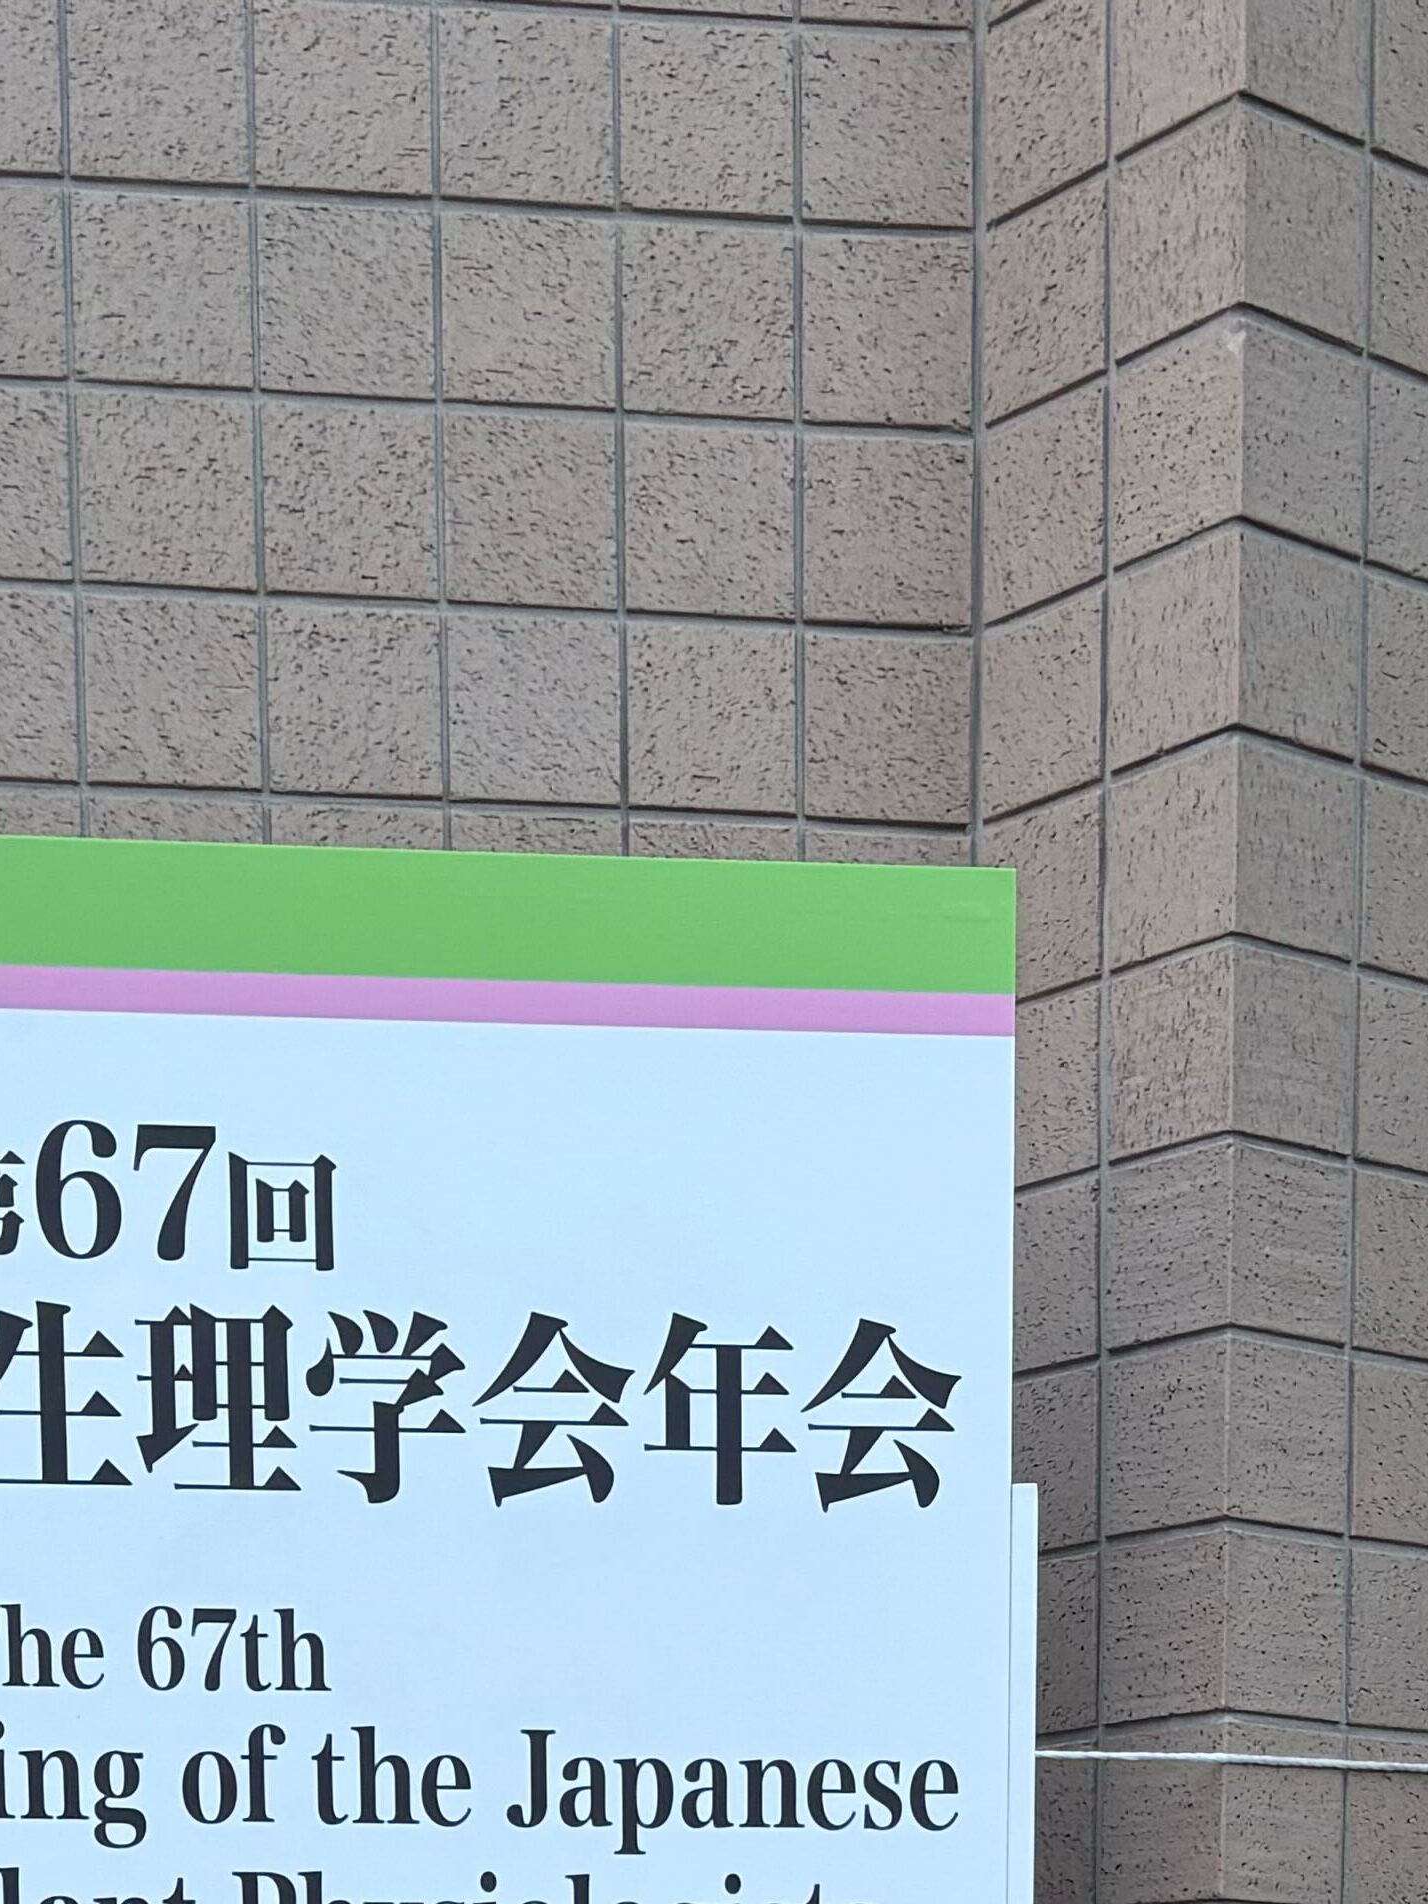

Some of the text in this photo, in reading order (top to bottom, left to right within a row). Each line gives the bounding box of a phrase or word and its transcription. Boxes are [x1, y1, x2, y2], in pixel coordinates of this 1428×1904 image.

[136, 1606, 332, 1692] 67th
[181, 1723, 286, 1825] of
[312, 1725, 471, 1826] the
[507, 1729, 959, 1855] Japanese
